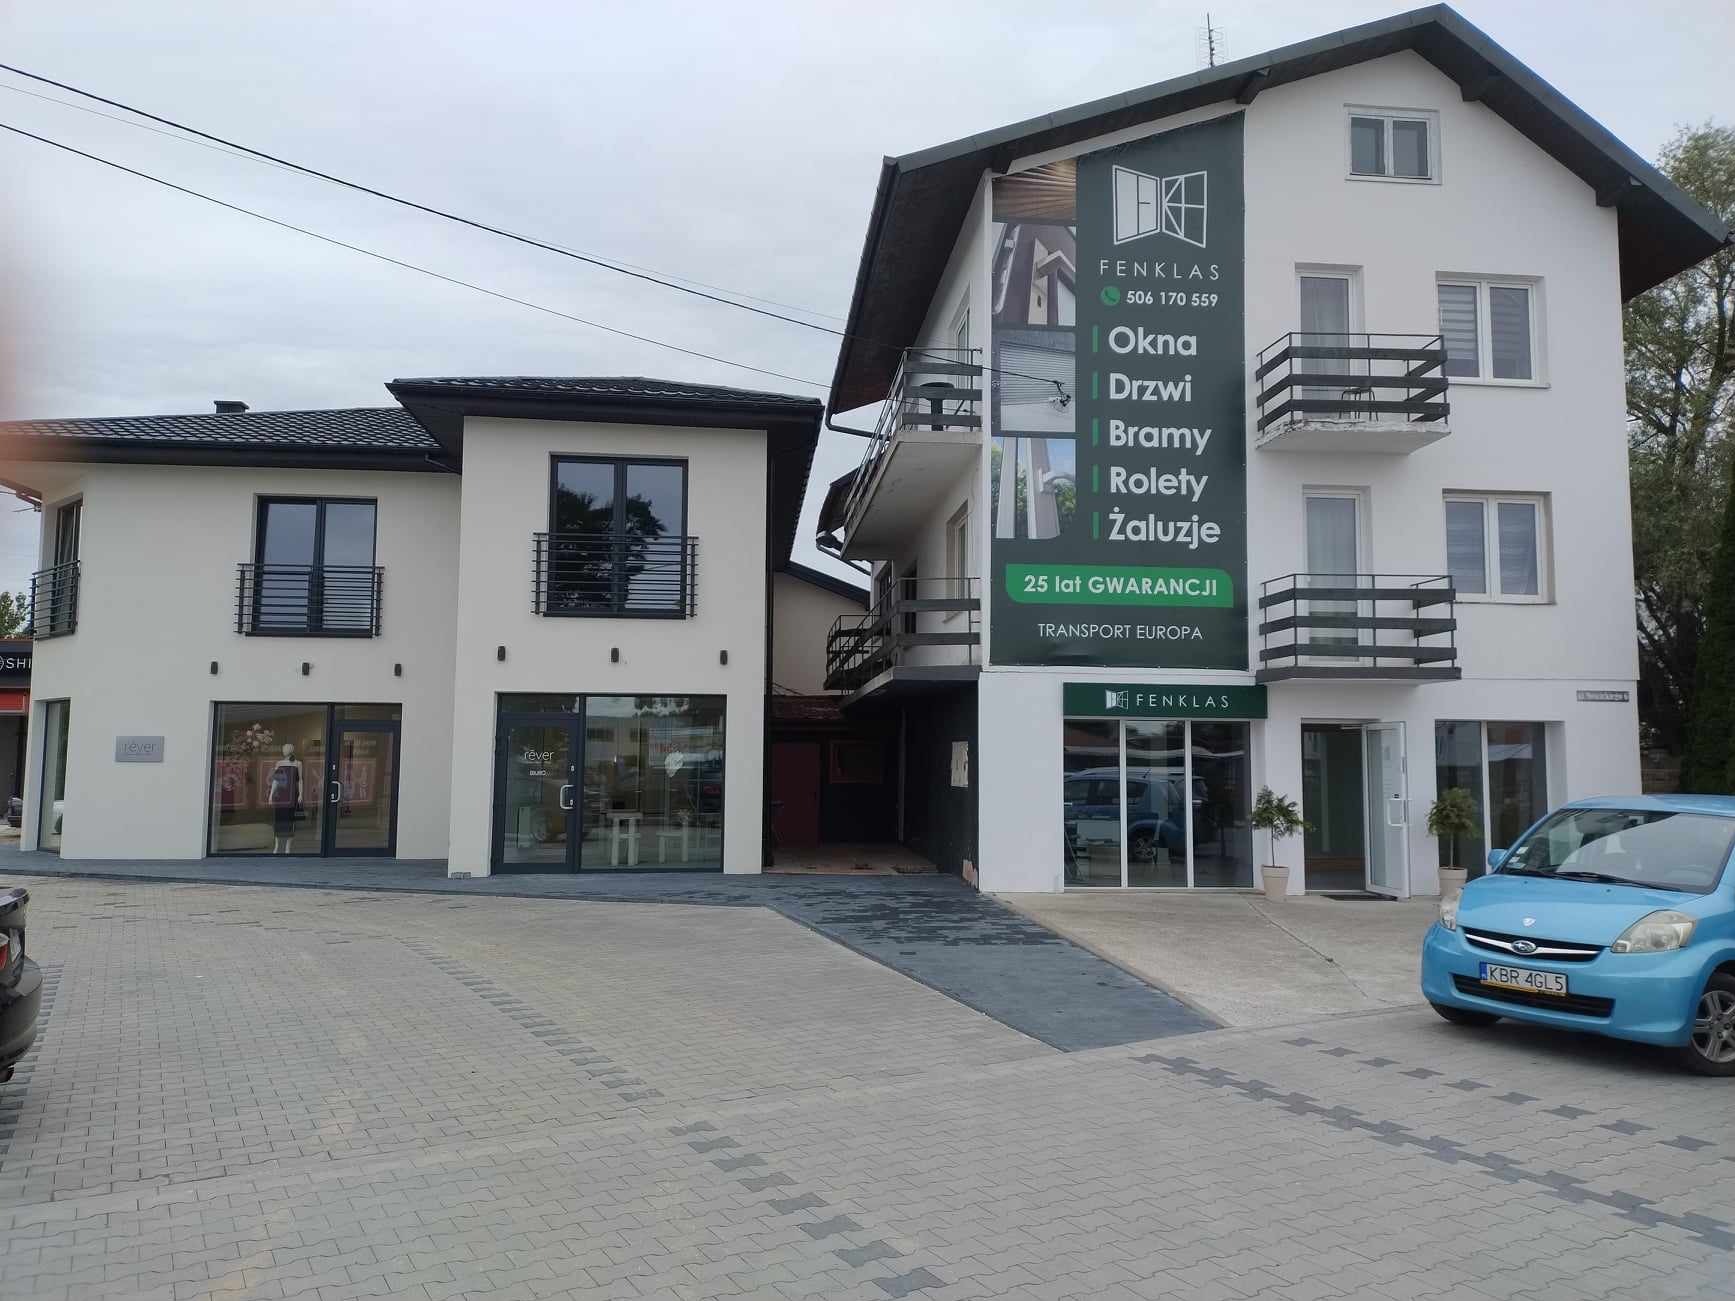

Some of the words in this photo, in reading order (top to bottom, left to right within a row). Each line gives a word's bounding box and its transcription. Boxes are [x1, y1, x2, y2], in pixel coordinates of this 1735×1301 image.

[1100, 259, 1220, 280] FENKLAS
[1126, 290, 1153, 305] 506
[1160, 291, 1187, 306] 170
[1191, 292, 1218, 307] 559
[1108, 325, 1197, 356] Okna
[1109, 372, 1192, 402] Drzwi
[1110, 419, 1212, 456] Bramy
[1110, 466, 1208, 502] Rolety
[1108, 507, 1221, 550] Żaluzje
[1024, 574, 1048, 592] 25
[1055, 575, 1081, 593] lat
[1088, 576, 1217, 597] GWARANCJI
[1038, 623, 1131, 639] TRANSPORT
[1136, 625, 1203, 641] EUROPA
[1136, 693, 1229, 709] FENKLAS
[1489, 966, 1520, 984] KBR
[1525, 972, 1564, 991] 4GL5
